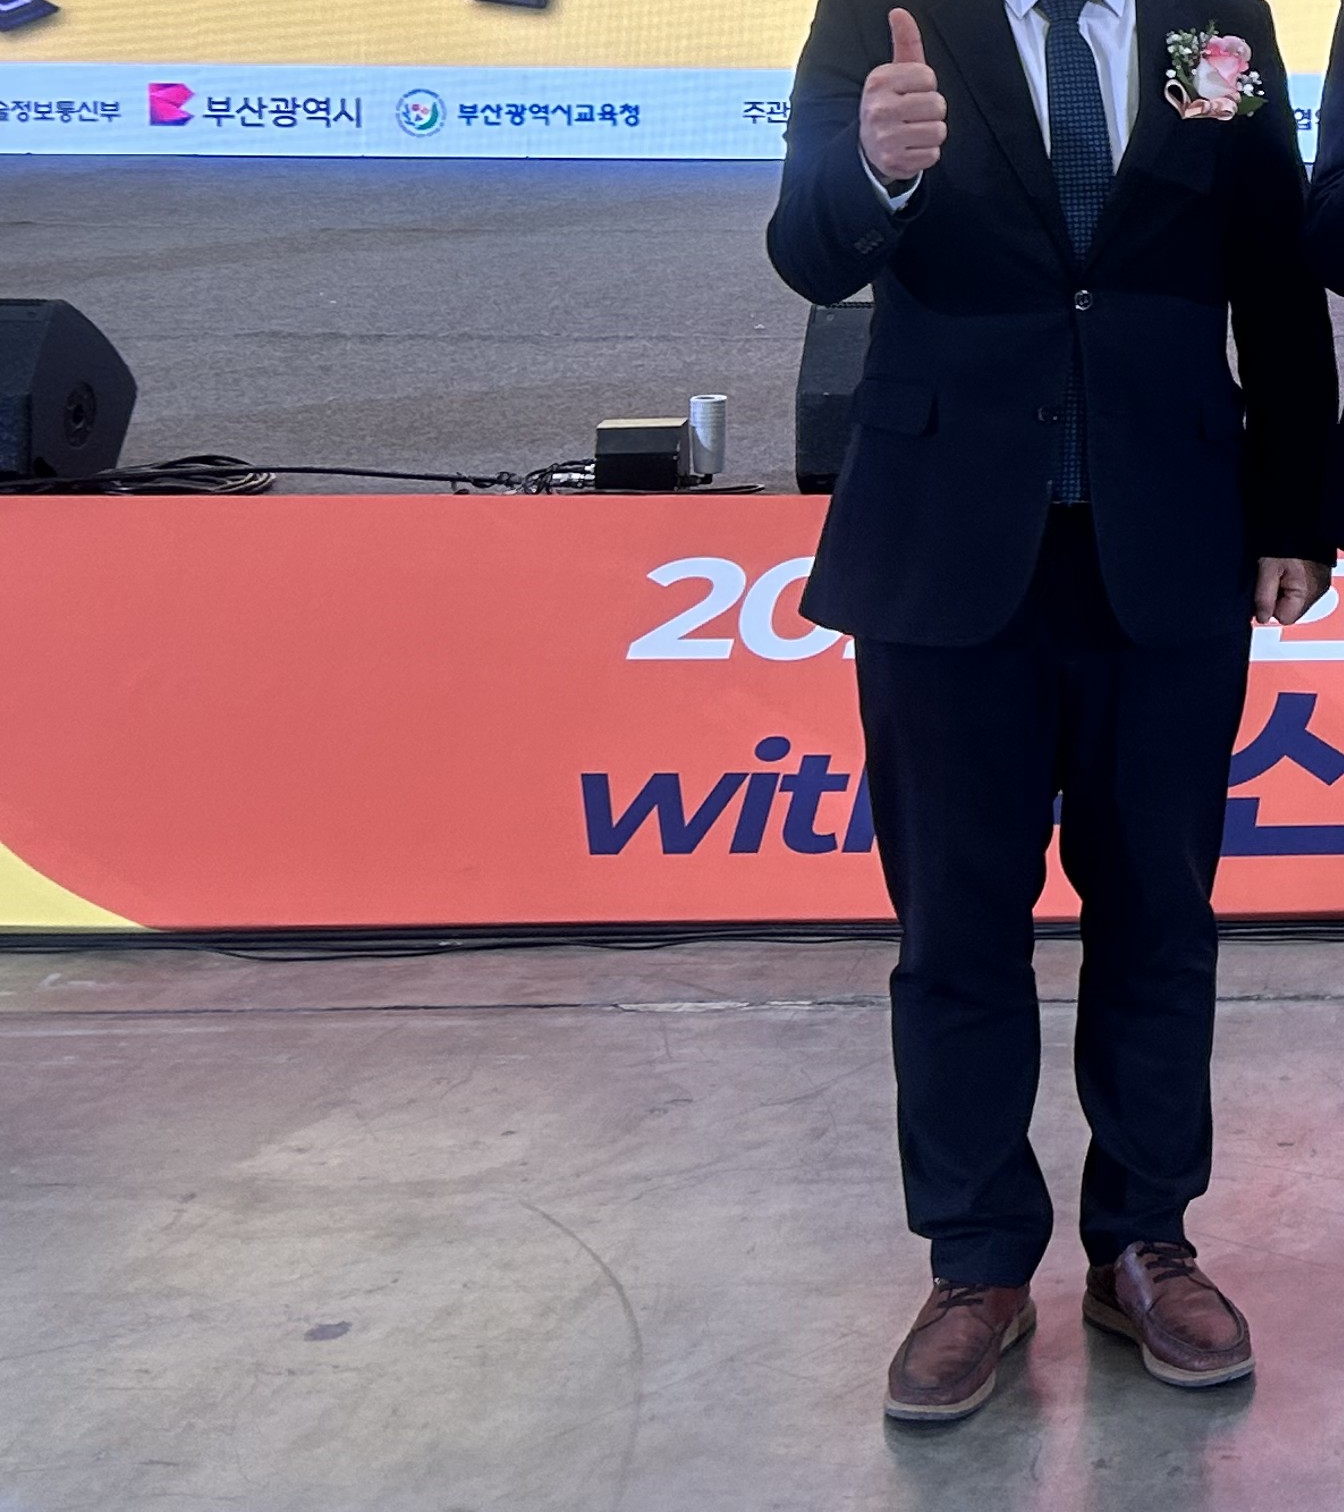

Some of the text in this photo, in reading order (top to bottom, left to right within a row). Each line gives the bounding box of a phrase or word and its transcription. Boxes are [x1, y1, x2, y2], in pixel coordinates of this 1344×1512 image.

[202, 96, 363, 129] 부산광역시
[456, 101, 641, 129] 부산광역시교육청
[742, 100, 791, 124] 주관
